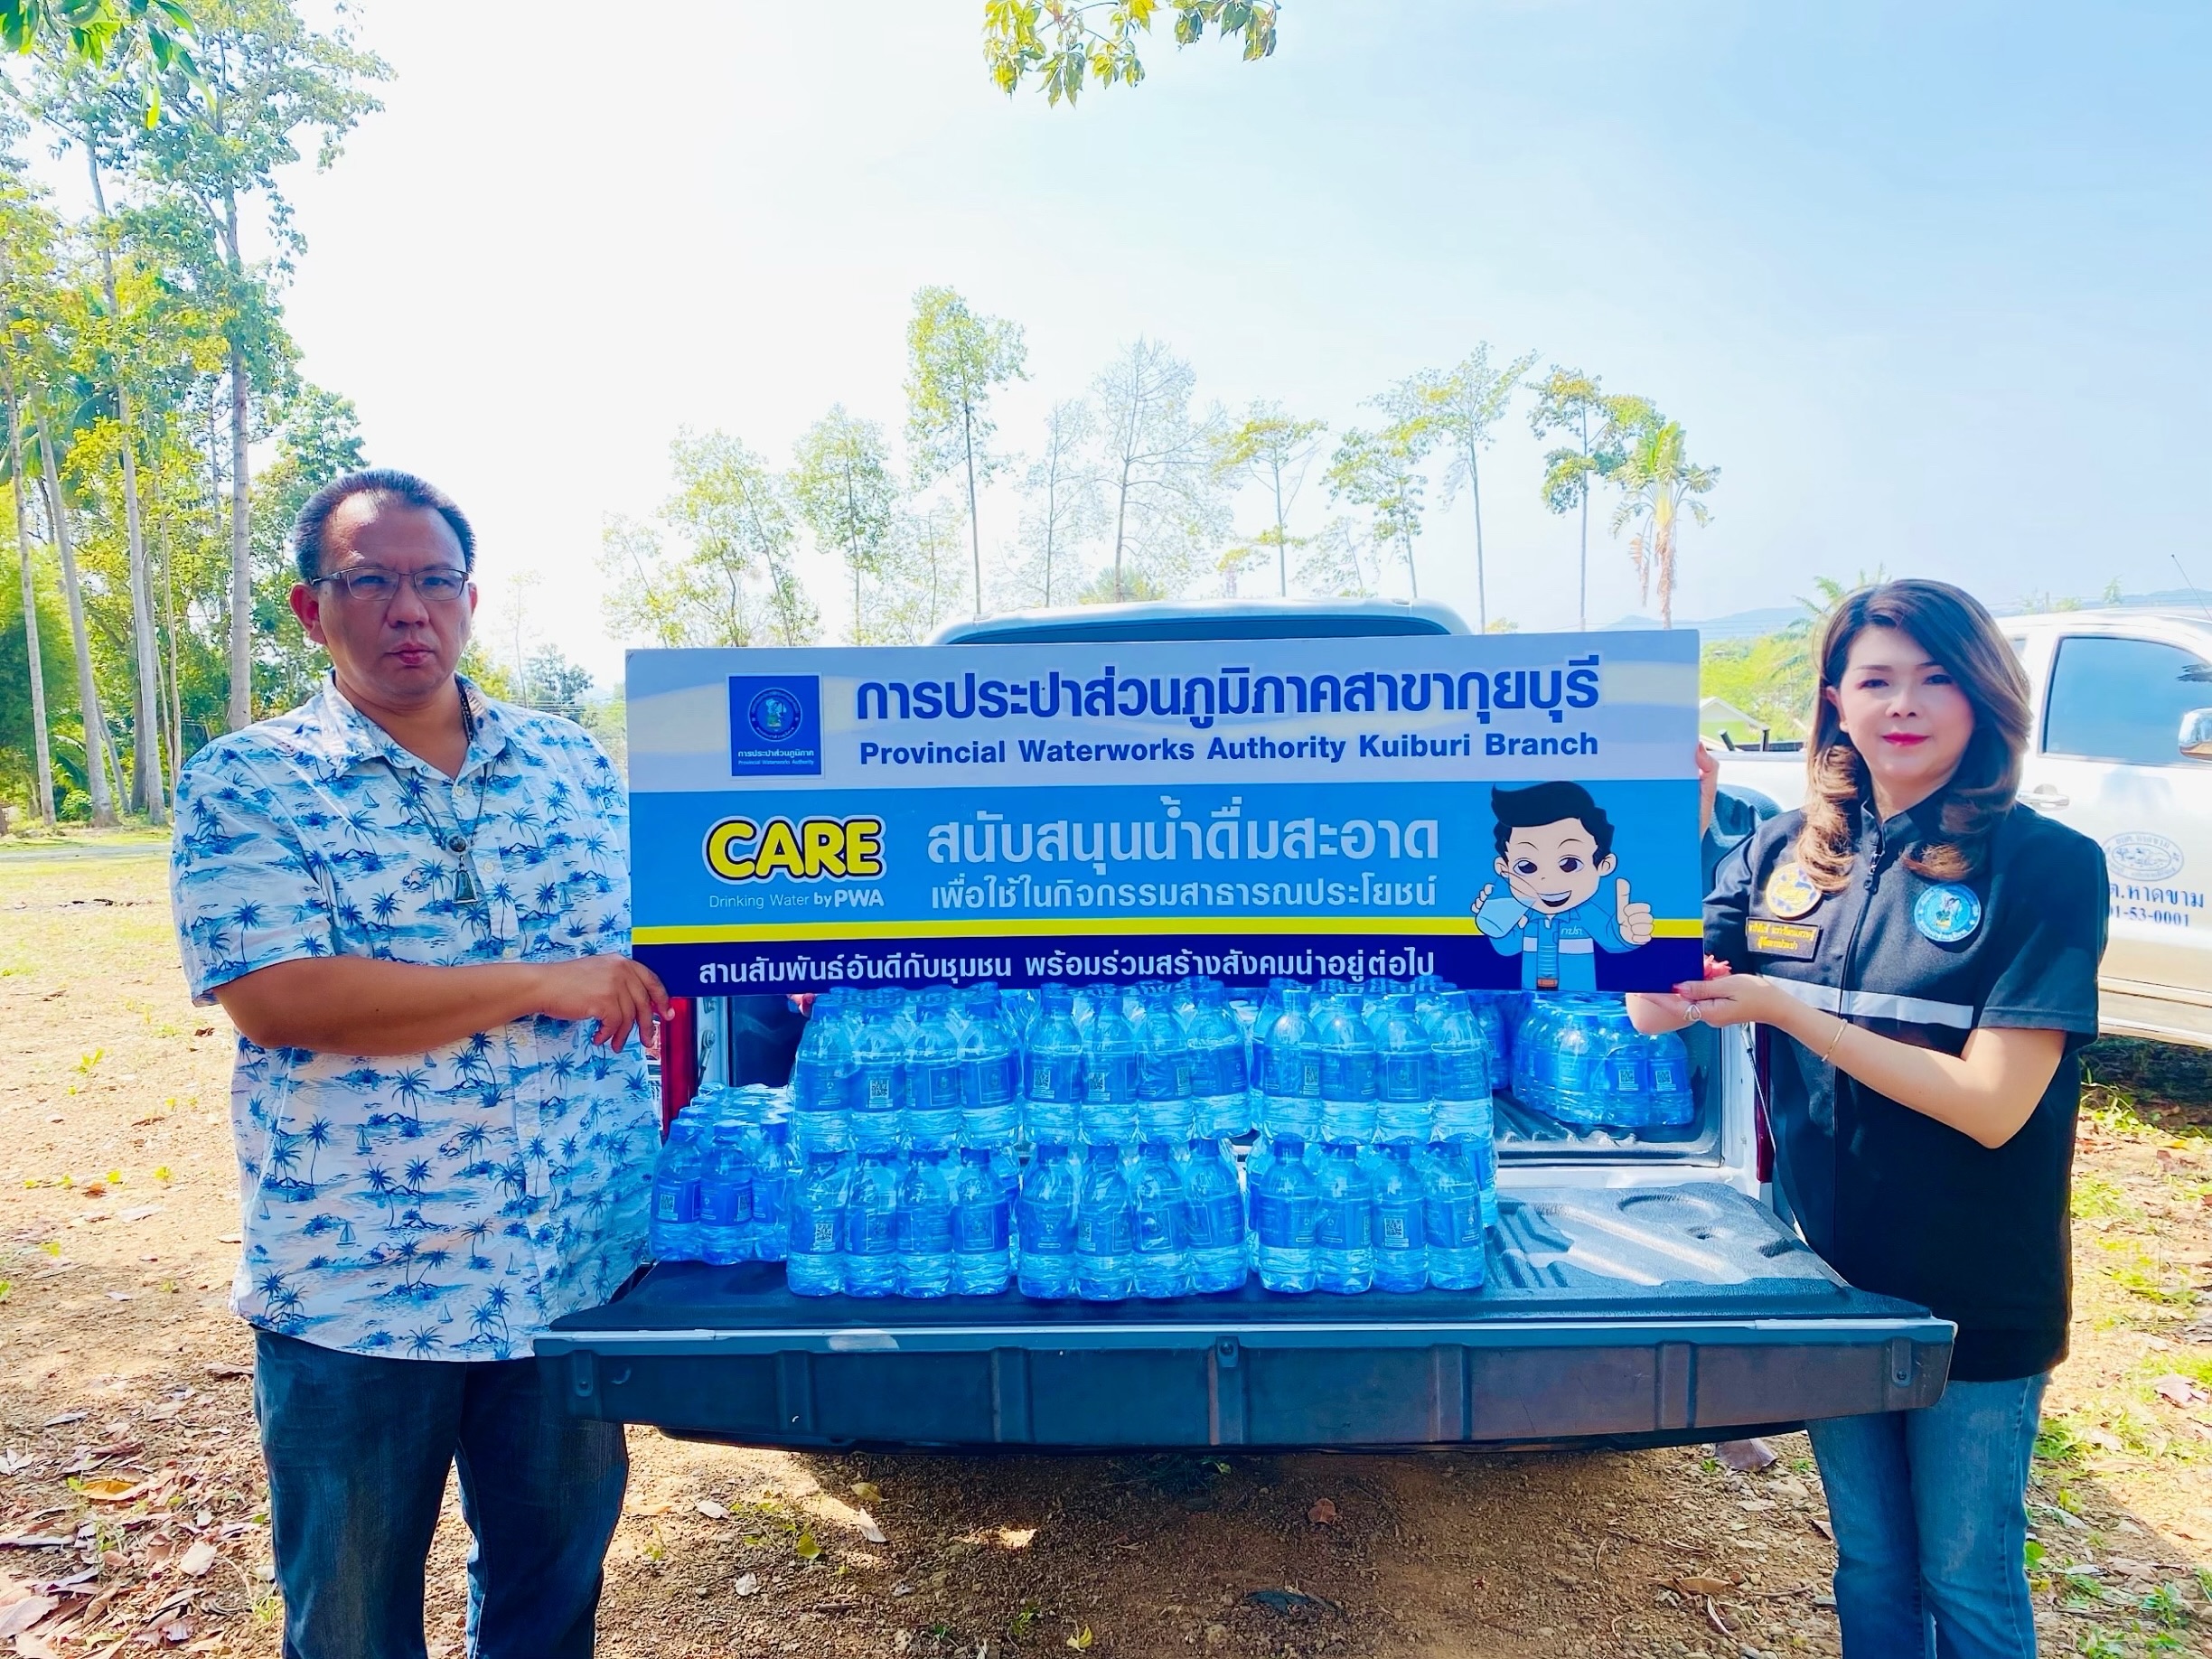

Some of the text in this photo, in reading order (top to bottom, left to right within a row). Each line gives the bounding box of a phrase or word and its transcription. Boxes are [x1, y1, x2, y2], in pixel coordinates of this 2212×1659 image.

[857, 654, 1599, 729] การประปาส่วนภูมิภาคสาขากุยบุรี
[859, 731, 1598, 764] Provincial Waterworks Authority Kuiburi Branch
[706, 818, 884, 881] CARE
[927, 794, 1439, 876] สนับสนุนน้ำดื่มสะอาด
[708, 888, 885, 909] Drinking Water by PWA
[931, 871, 1438, 910] เพื่อใช้ในกิจกรรมสาธารณประโยชน์
[698, 951, 1011, 985] สานสัมพันธ์อันดีกับชุมชน
